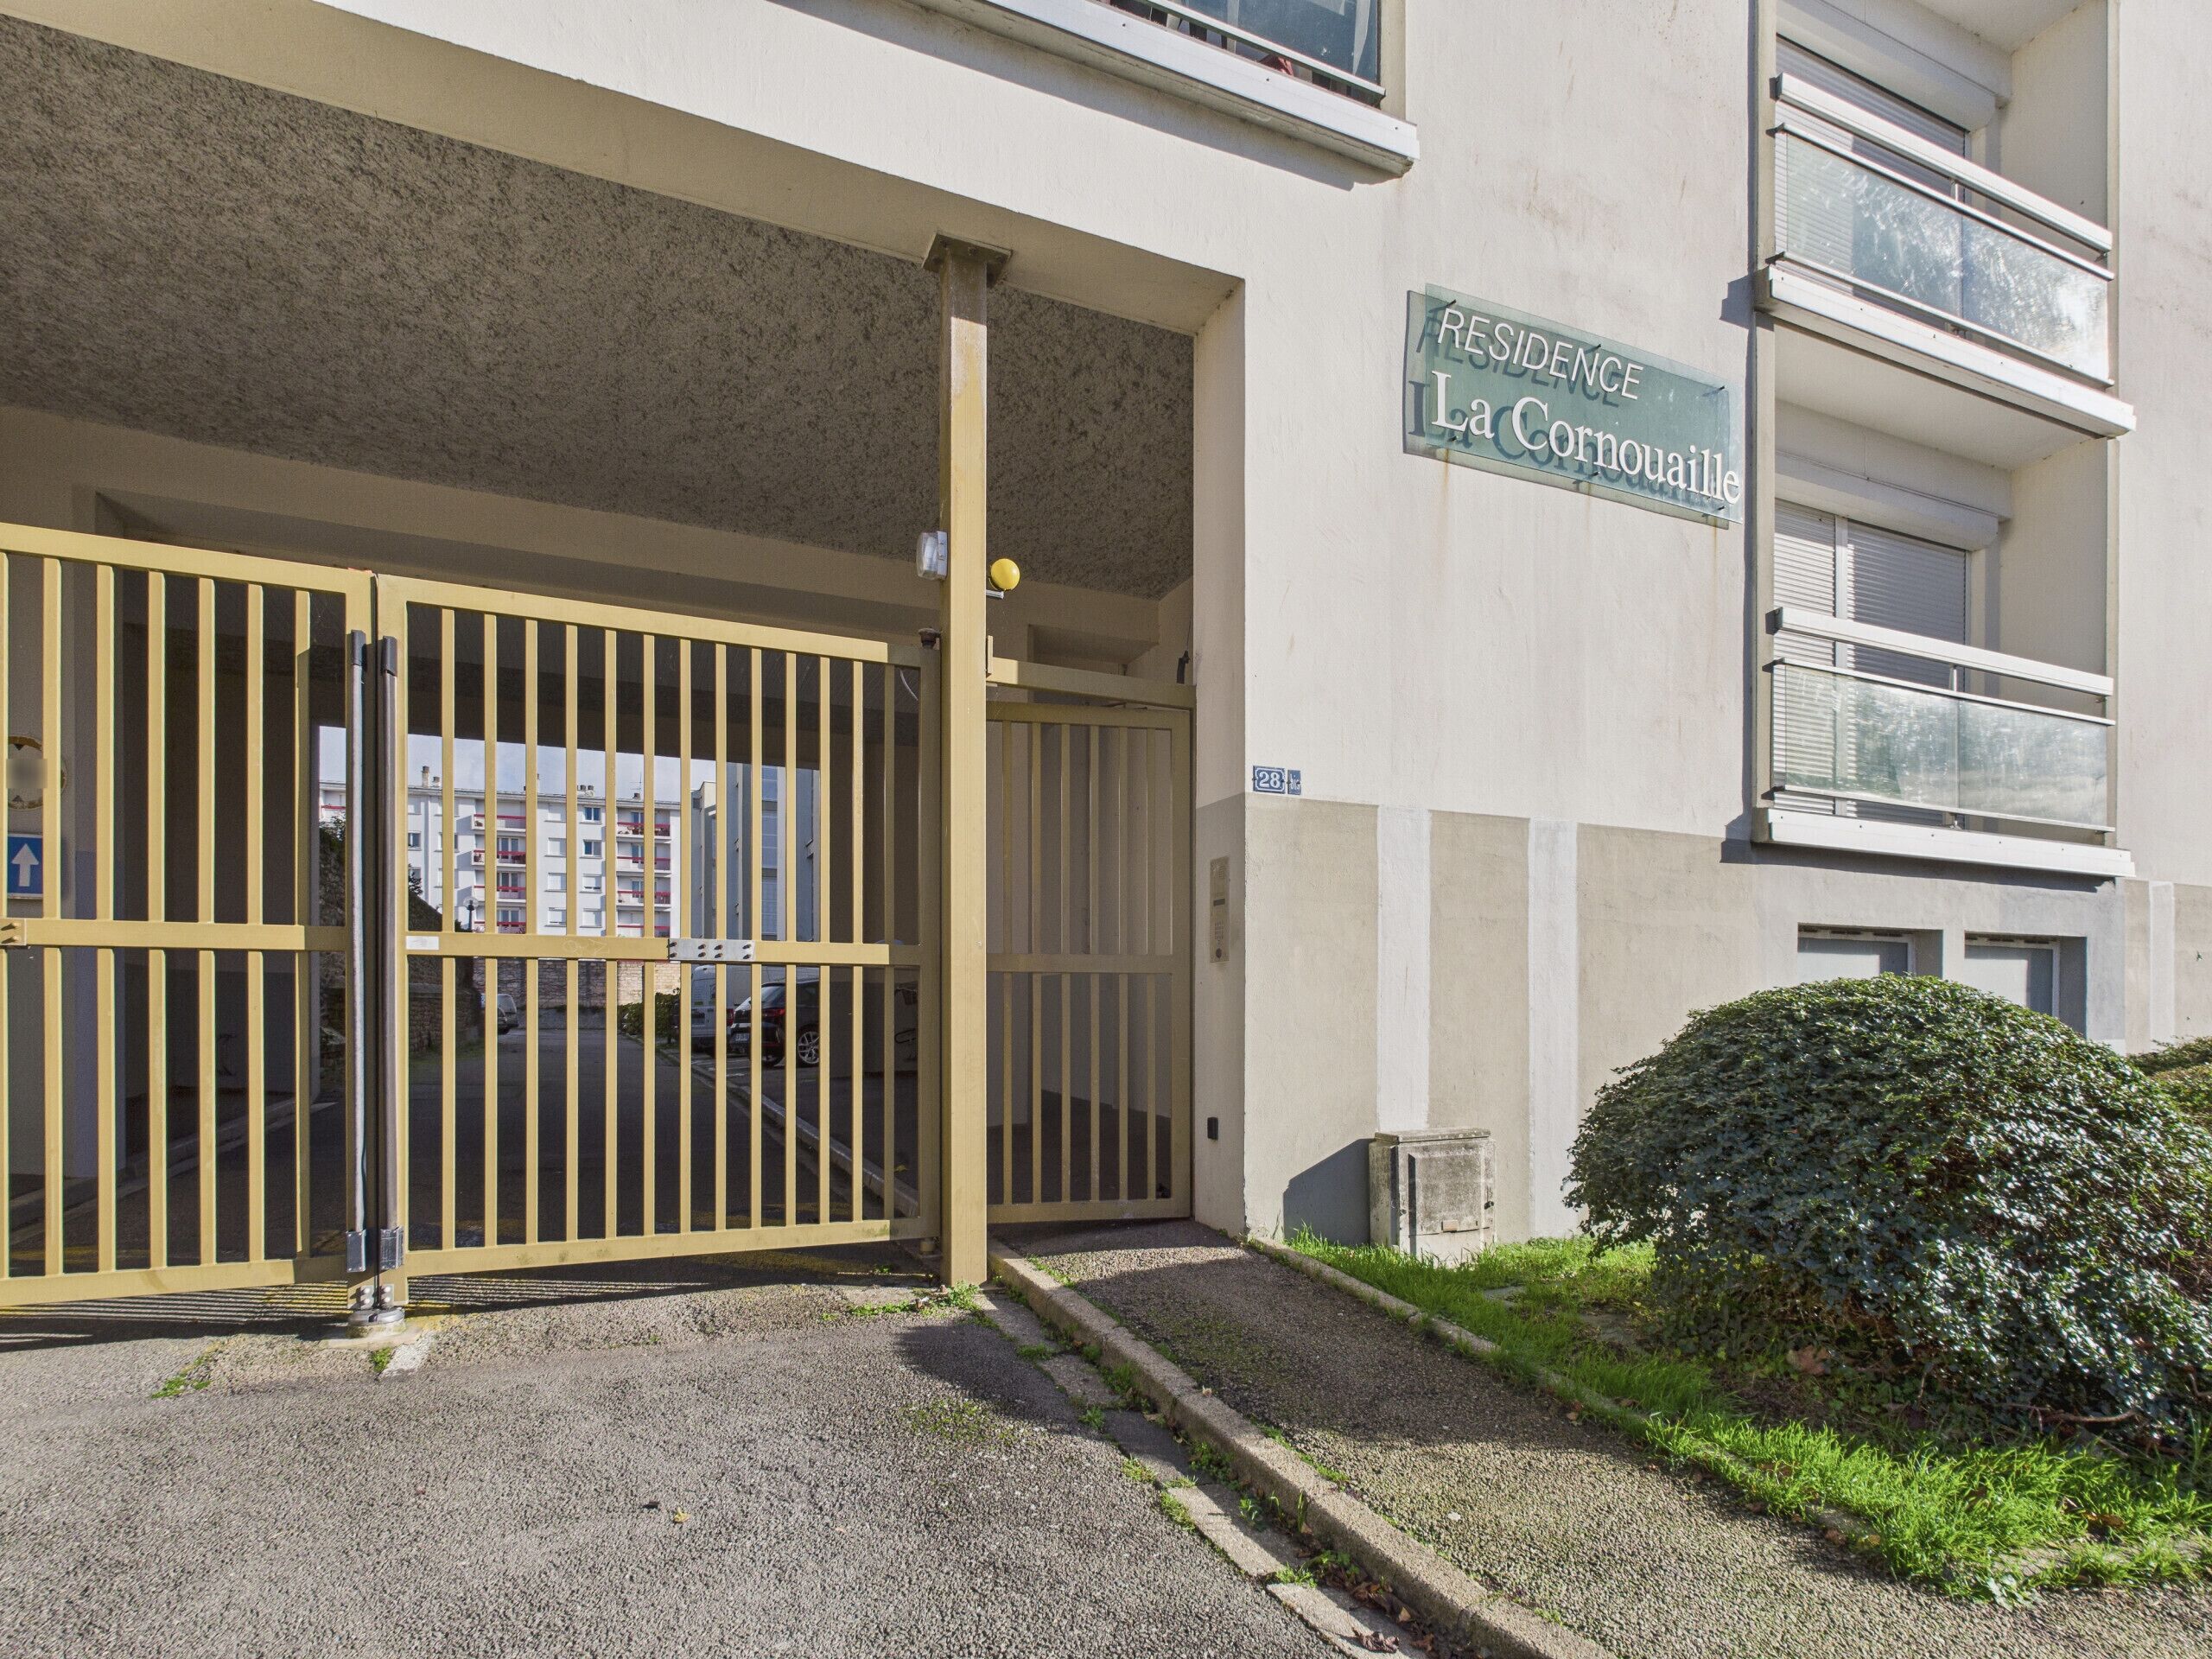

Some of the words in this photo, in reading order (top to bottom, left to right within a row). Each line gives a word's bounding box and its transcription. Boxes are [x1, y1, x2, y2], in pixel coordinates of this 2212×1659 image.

[1437, 308, 1643, 400] RESIDENCE
[1431, 370, 1495, 440] La
[1511, 396, 1742, 505] Cornouaille
[1259, 771, 1281, 789] 28
[1289, 773, 1300, 790] bis
